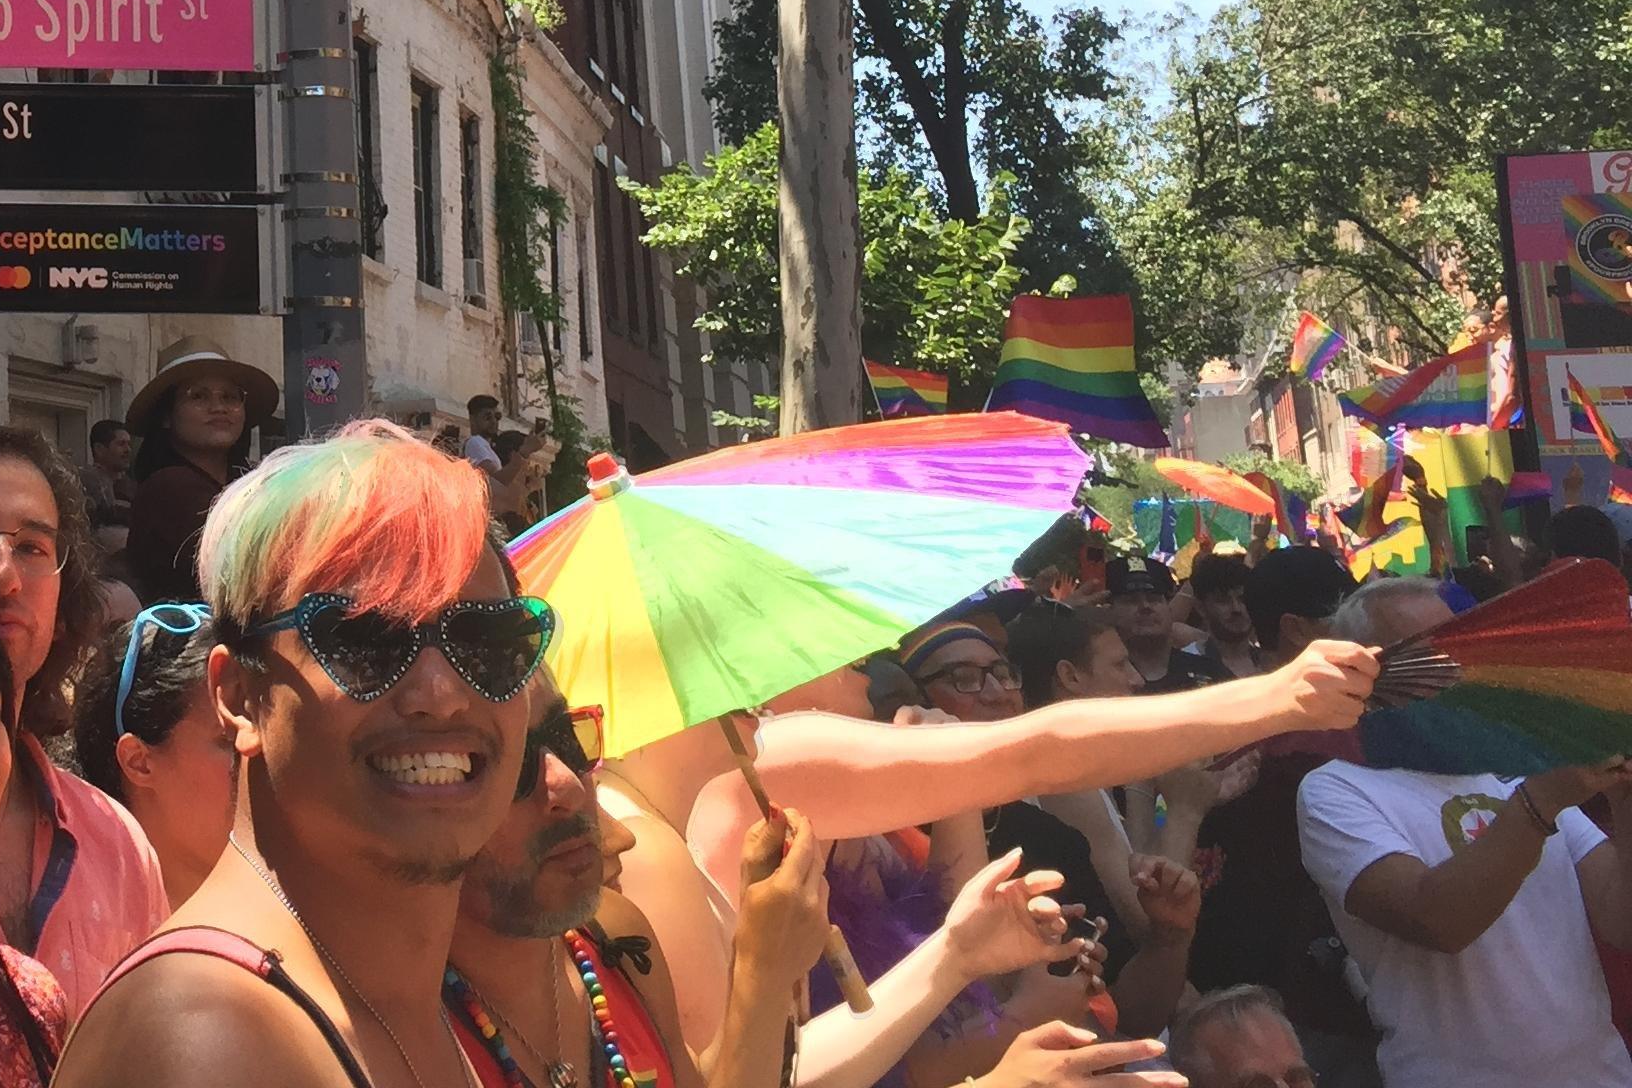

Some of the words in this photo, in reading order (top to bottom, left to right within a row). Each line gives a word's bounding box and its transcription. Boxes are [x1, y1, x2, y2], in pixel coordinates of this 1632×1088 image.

[1, 101, 33, 140] St
[49, 266, 109, 289] NYC
[111, 271, 166, 281] Commission
[167, 272, 180, 281] on
[111, 281, 144, 290] Human
[145, 281, 174, 291] Rights
